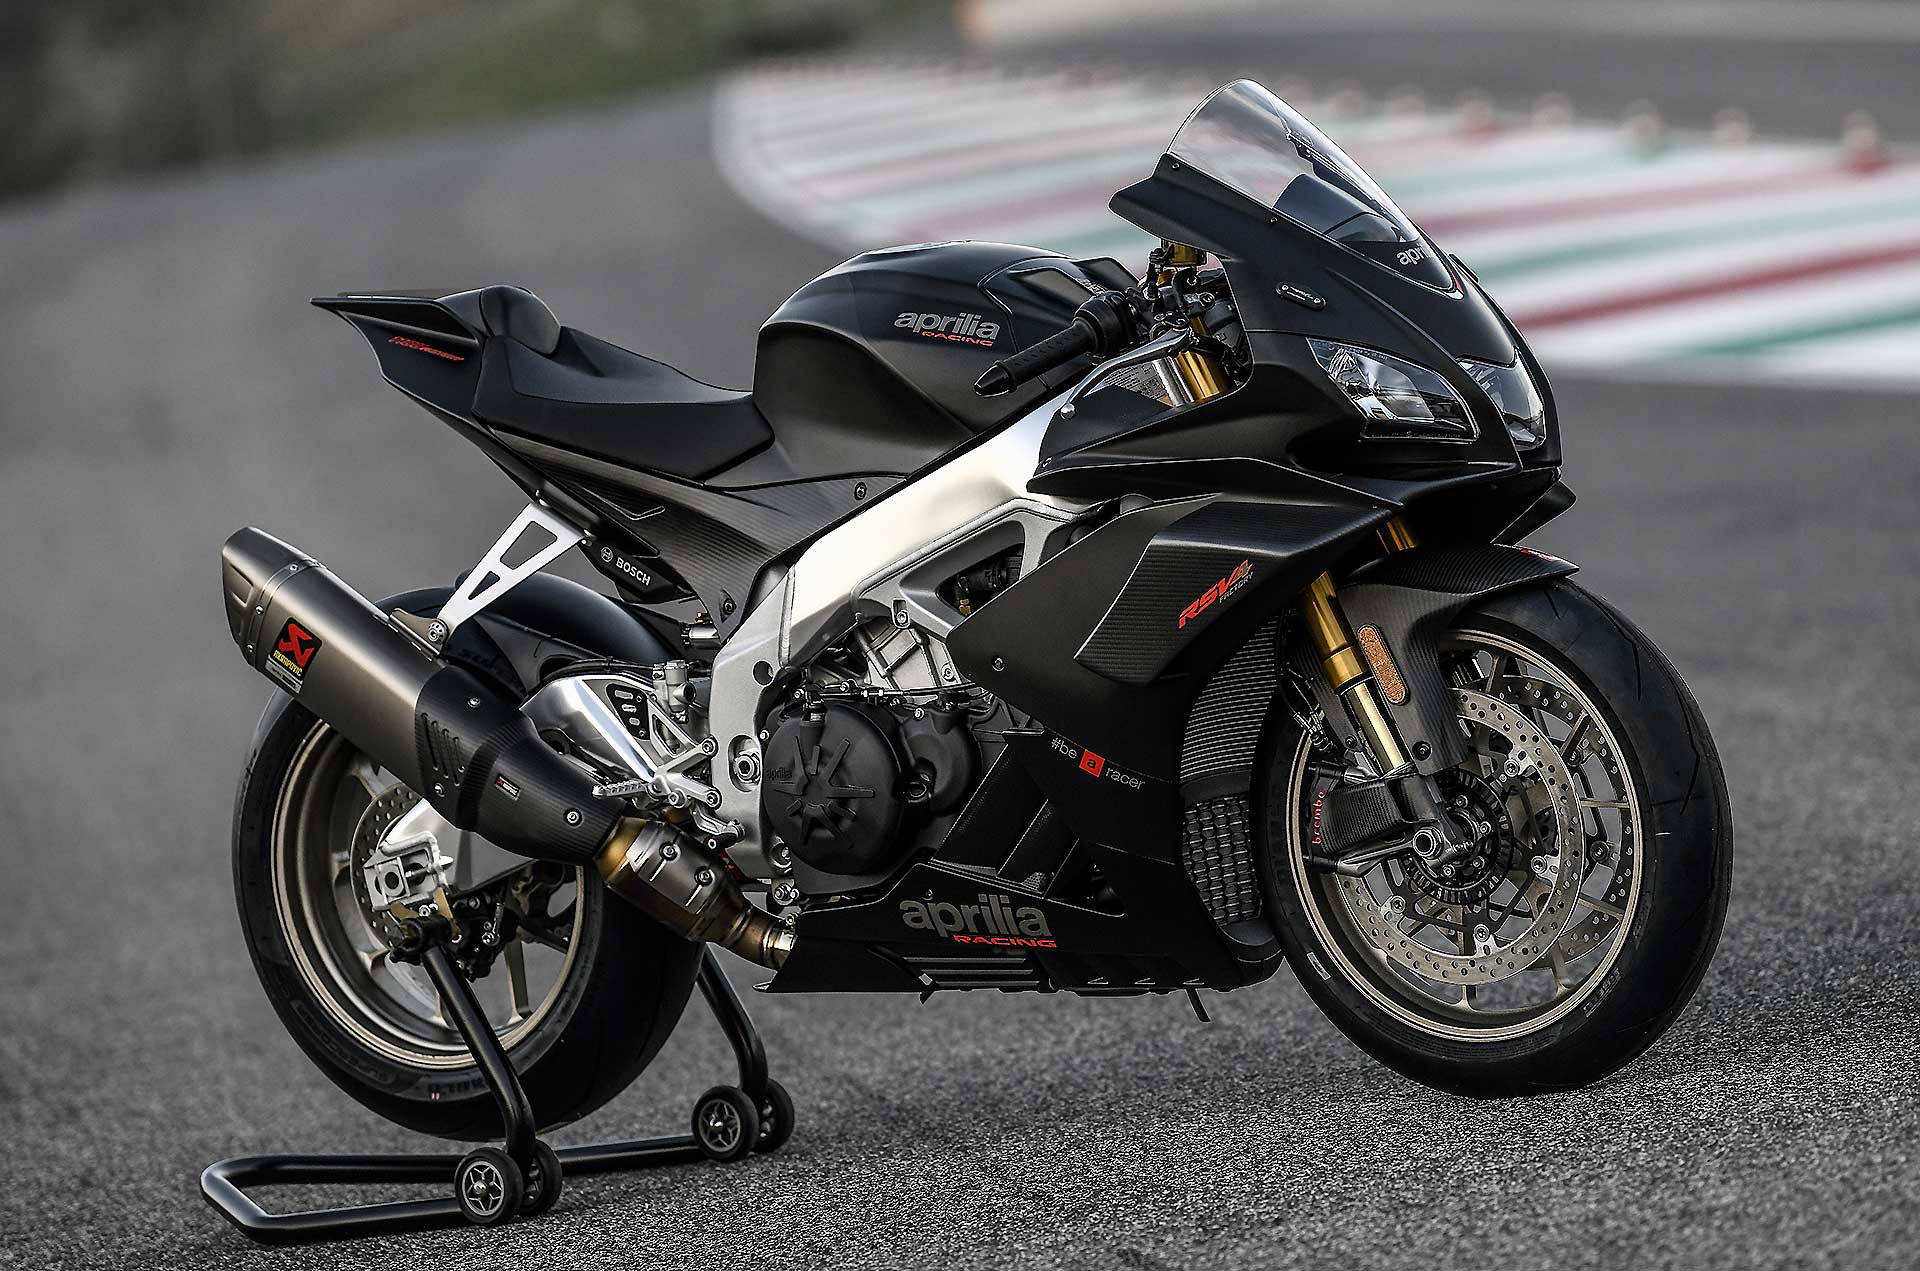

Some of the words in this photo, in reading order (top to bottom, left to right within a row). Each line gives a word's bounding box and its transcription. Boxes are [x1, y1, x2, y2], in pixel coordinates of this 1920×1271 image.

[894, 312, 1001, 340] aprilia
[921, 331, 994, 347] RACING
[616, 556, 651, 586] BOSCH
[1219, 571, 1254, 604] FACTORY
[1179, 559, 1253, 629] RSV4
[1051, 737, 1078, 759] #be
[1105, 767, 1146, 790] racer
[1311, 791, 1326, 844] brembo
[899, 893, 1053, 938] aprilia
[952, 934, 1057, 948] RACING
